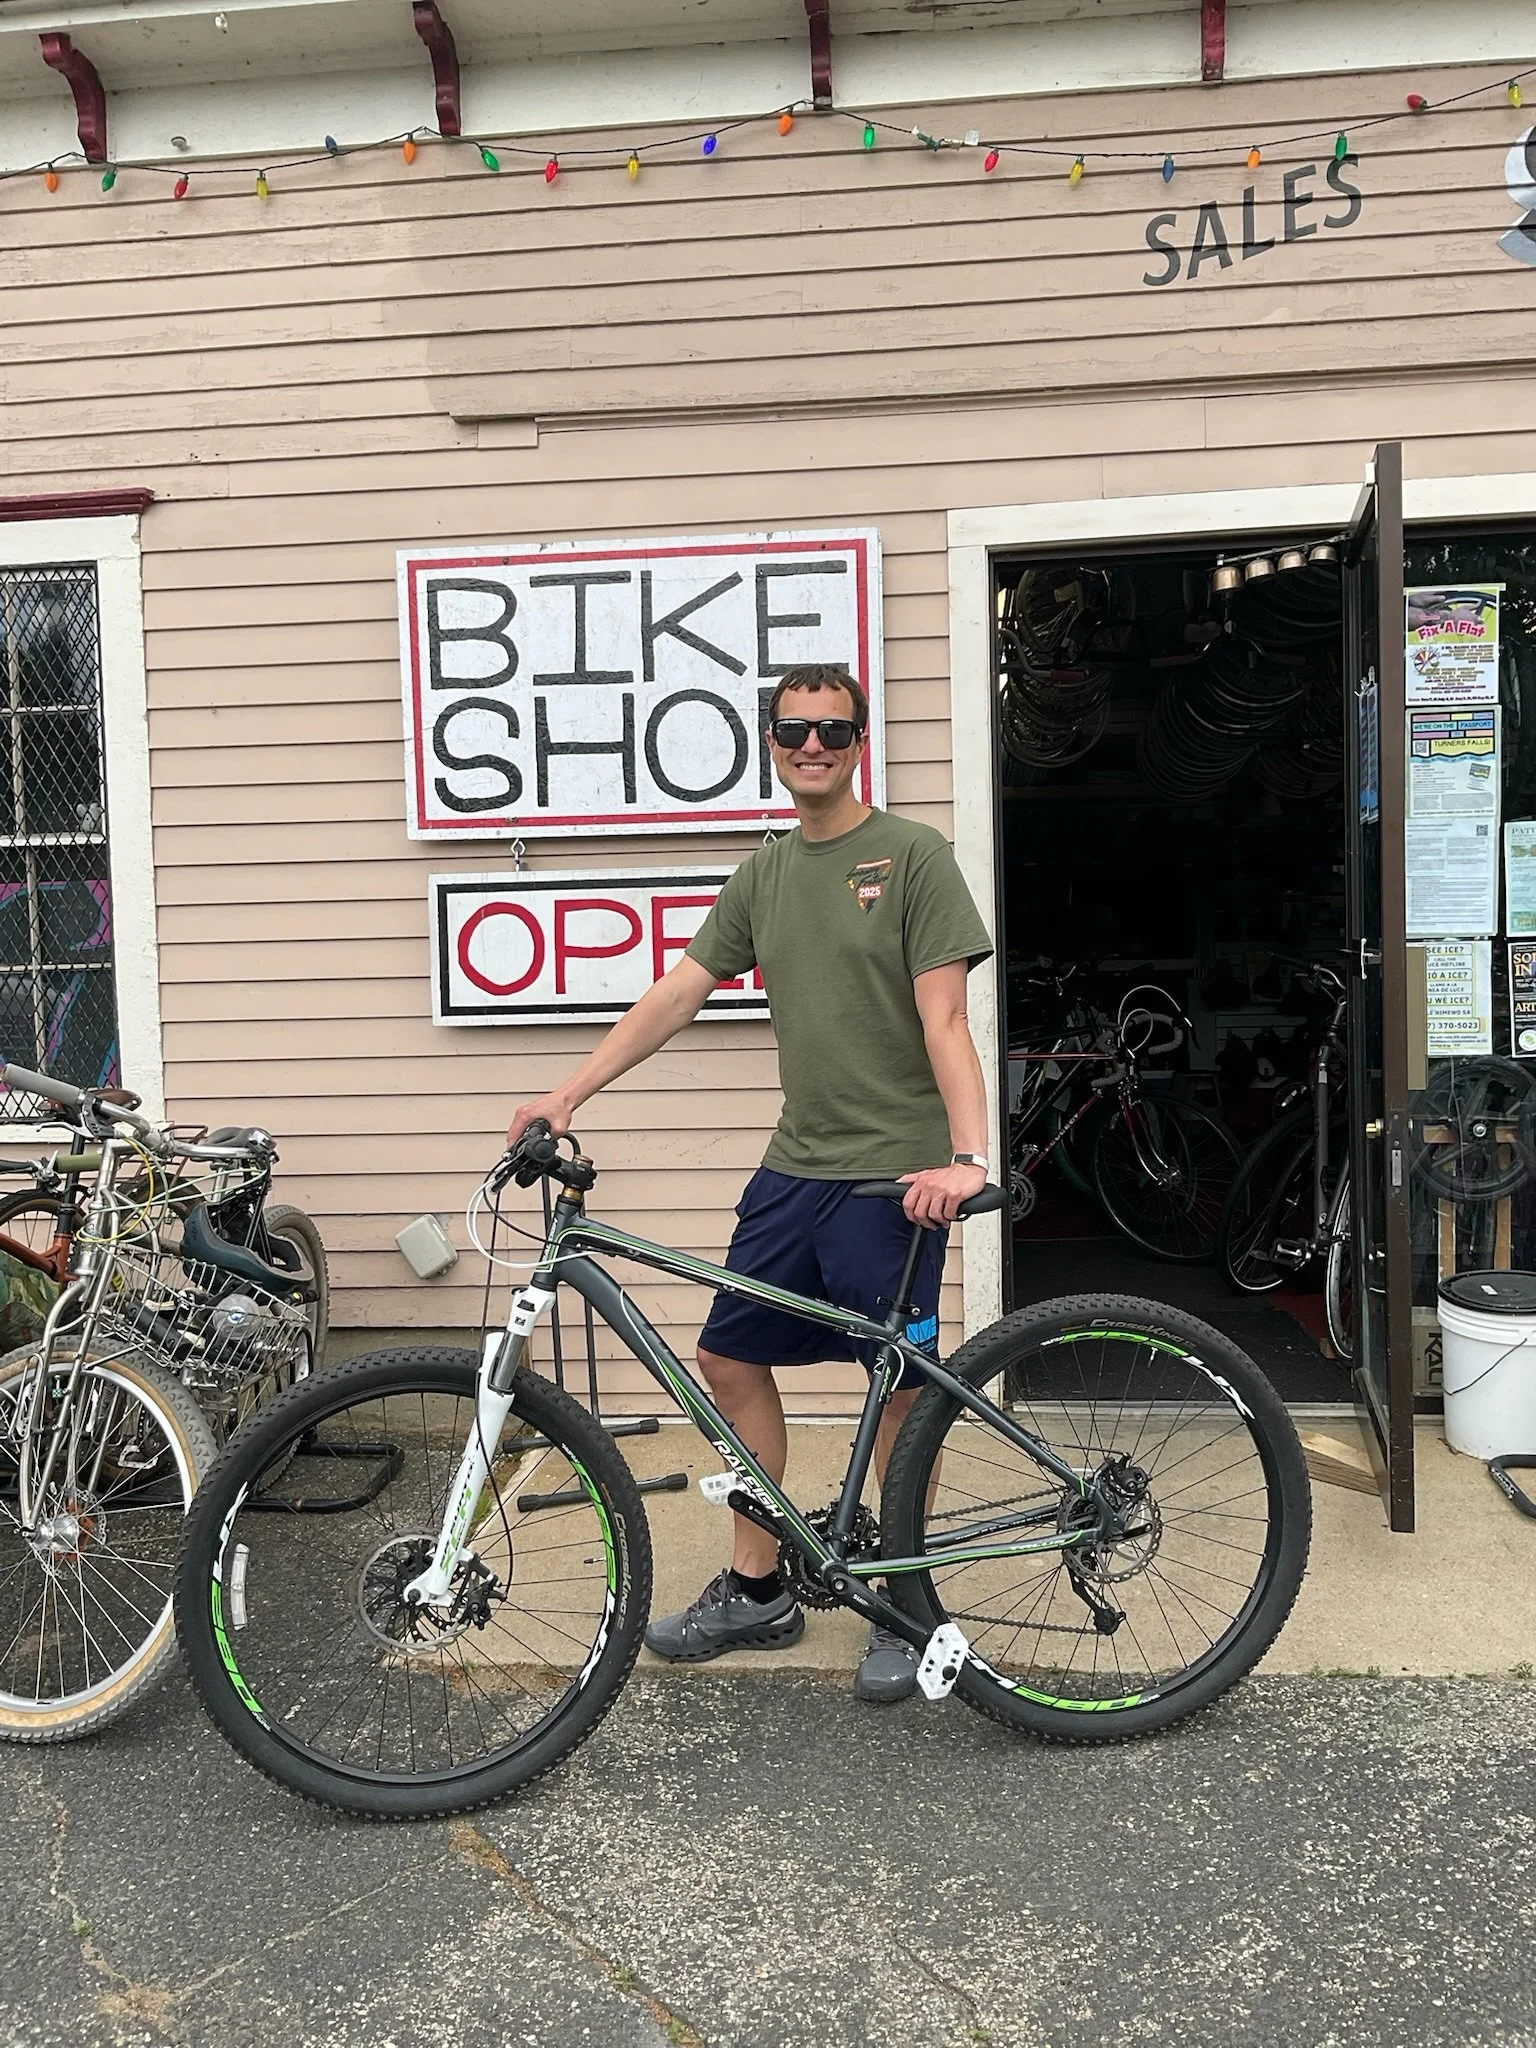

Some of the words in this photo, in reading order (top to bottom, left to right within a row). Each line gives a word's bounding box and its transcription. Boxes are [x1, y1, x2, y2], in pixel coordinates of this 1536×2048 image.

[1142, 153, 1362, 287] SALES
[426, 560, 850, 690] BIKE
[1418, 626, 1439, 640] Fix
[1445, 622, 1454, 633] A
[1458, 622, 1485, 637] Flat
[1460, 720, 1491, 728] PASSPORT
[859, 886, 881, 898] 2025
[457, 895, 766, 996] OPE
[1426, 946, 1442, 954] SEE
[712, 1440, 784, 1518] RALEIGH
